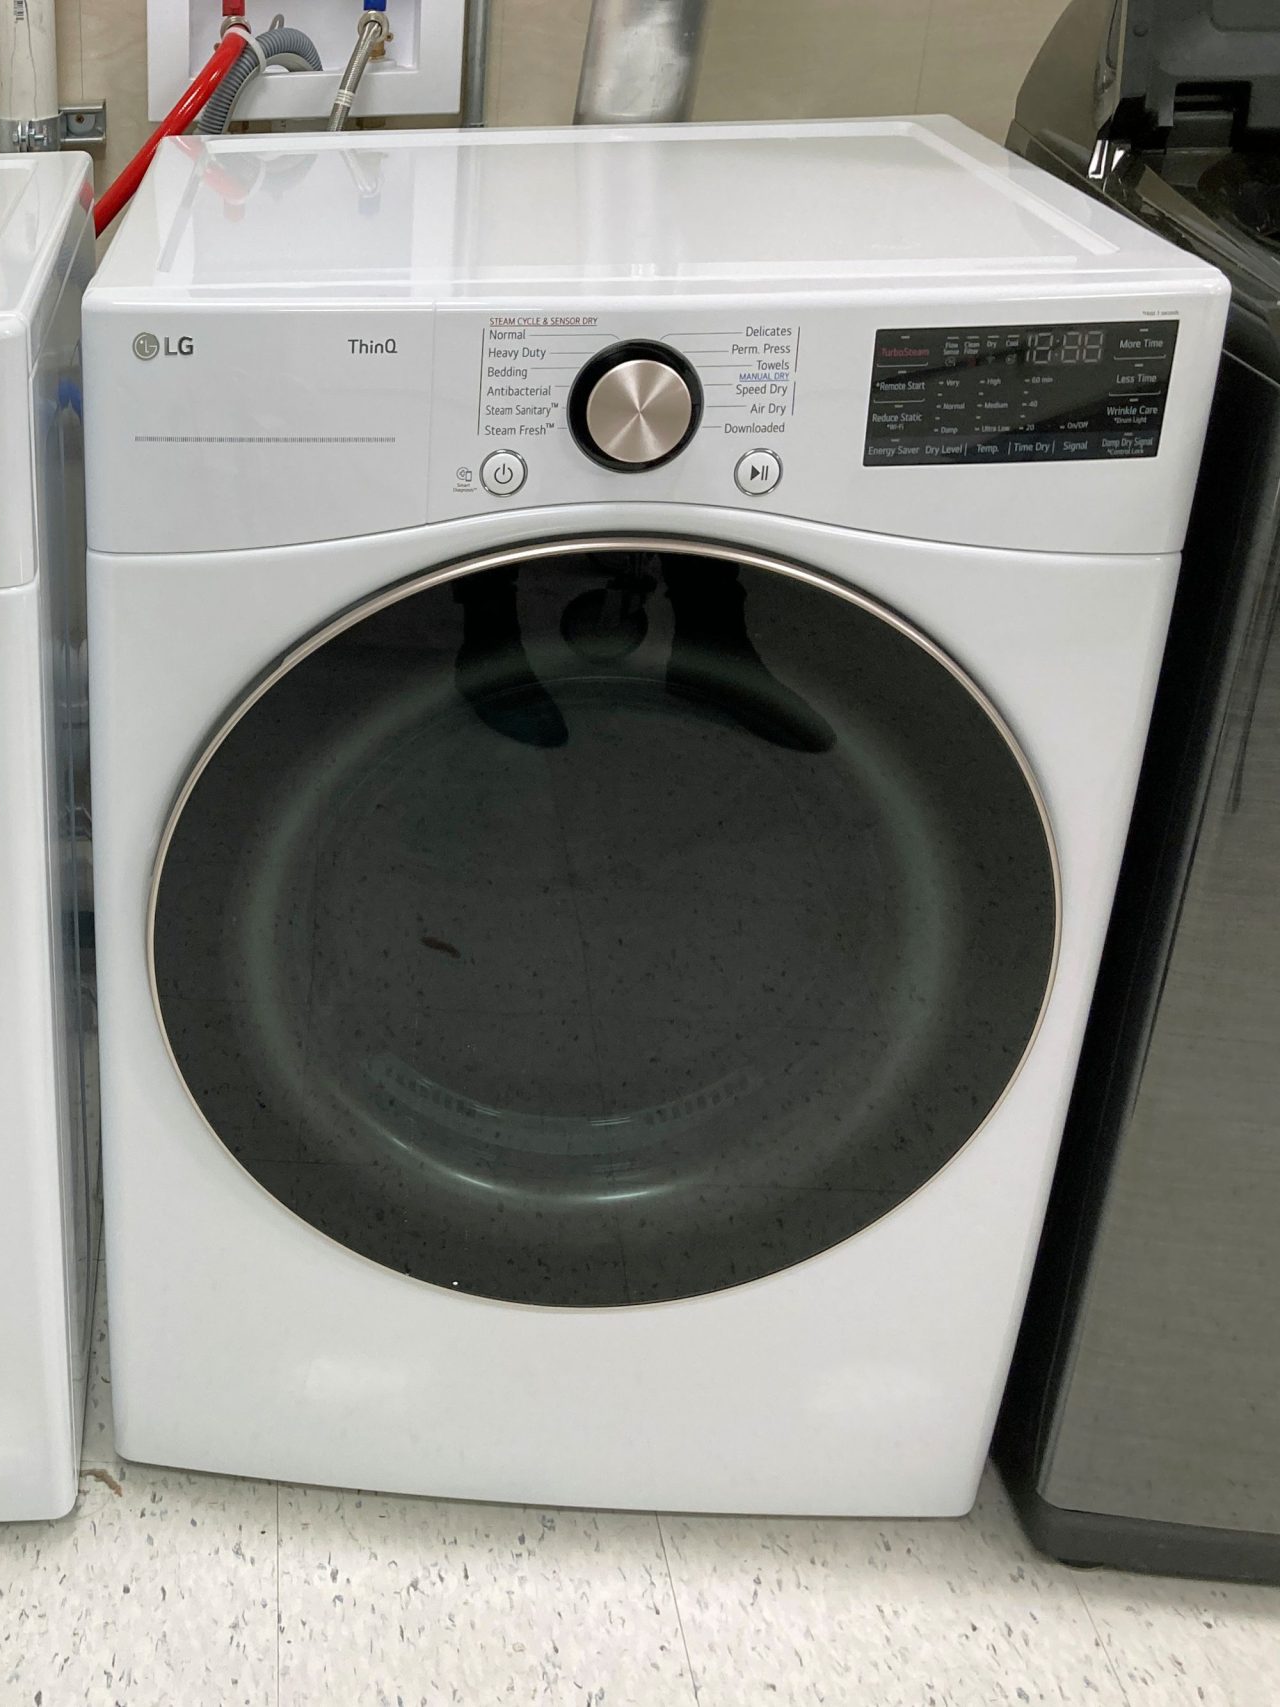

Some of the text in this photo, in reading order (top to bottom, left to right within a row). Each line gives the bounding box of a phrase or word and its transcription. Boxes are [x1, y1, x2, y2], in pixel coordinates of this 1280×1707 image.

[489, 316, 598, 327] STEAM CYCLE & SENSOR DRY
[489, 329, 526, 340] Normal
[746, 325, 792, 337] Delicates
[164, 336, 398, 356] LG ThinQ
[732, 343, 791, 355] Perm. Press
[1120, 338, 1163, 349] More Time
[488, 346, 546, 360] Heavy Duty
[756, 359, 790, 370] Towels
[487, 366, 528, 379] Bedding
[739, 372, 790, 382] MANUAL DRY
[1116, 373, 1157, 384] Less Time
[487, 385, 551, 396] Antibacterial
[736, 383, 788, 397] Speed Dry
[908, 380, 926, 390] Start
[485, 404, 513, 416] Steam
[750, 402, 786, 416] Air Dry
[1106, 405, 1158, 416] Wrinkle Care
[872, 412, 923, 422] Reduce Static
[484, 424, 516, 436] Steam
[724, 422, 785, 434] Downloaded
[1014, 442, 1051, 453] Time Dry
[1063, 440, 1088, 451] Signal
[1121, 437, 1133, 448] Dry
[868, 446, 920, 457] Energy Saver
[925, 444, 963, 456] Dry Level
[977, 444, 999, 455] Temp.
